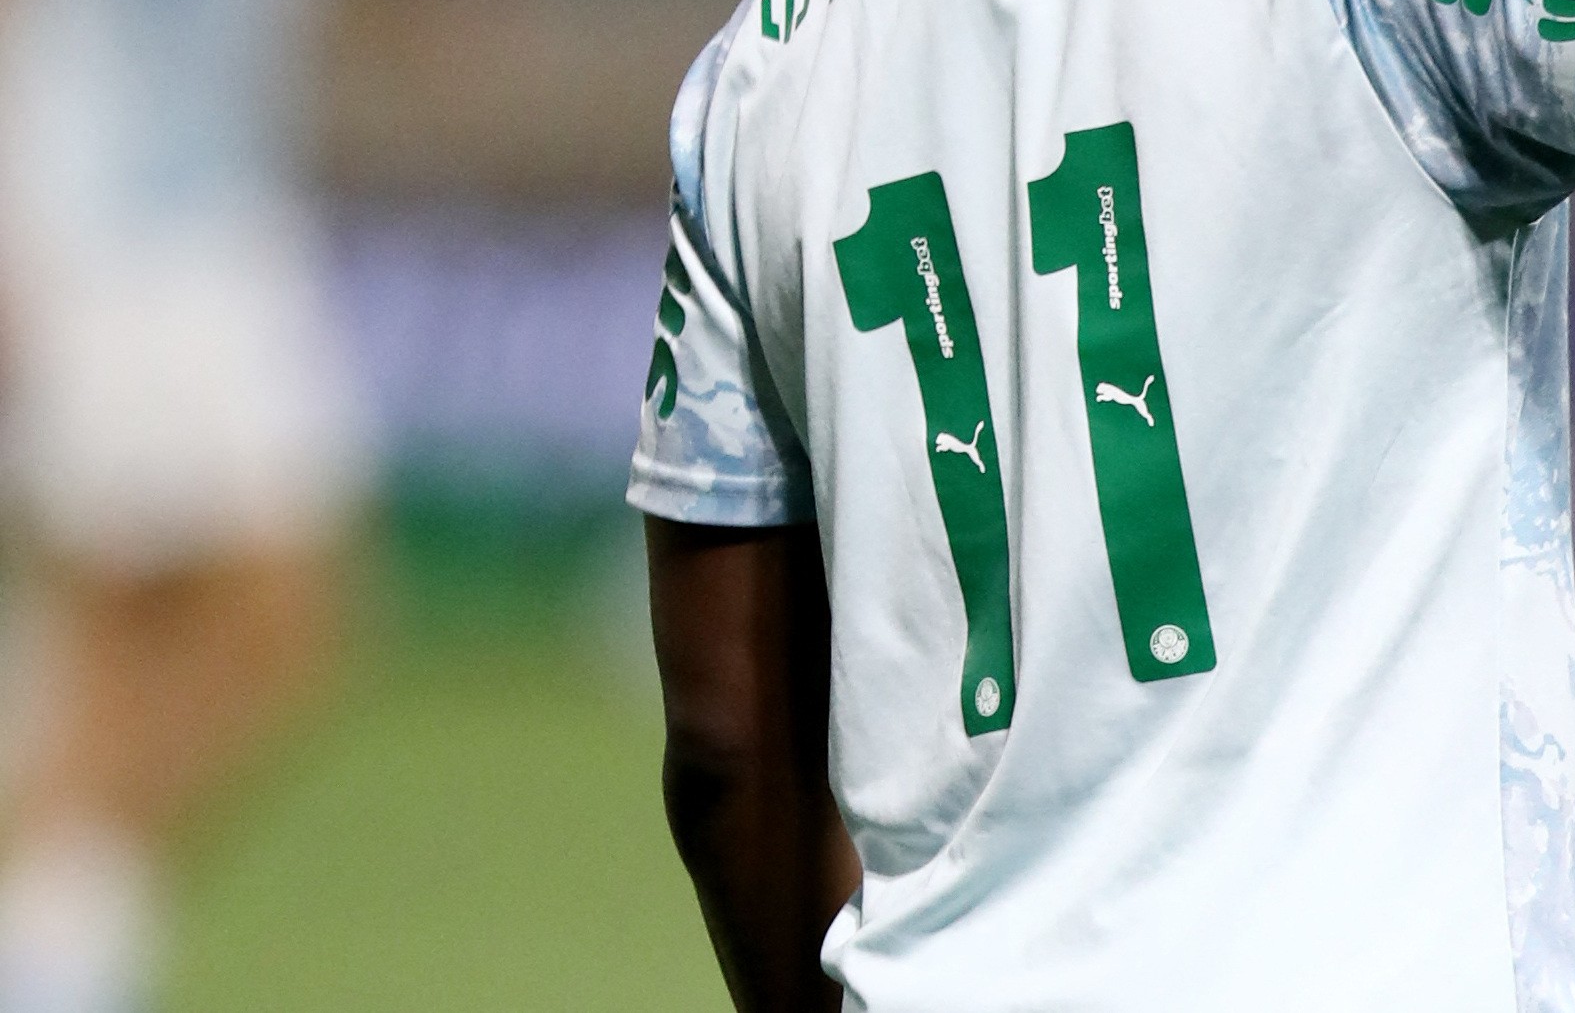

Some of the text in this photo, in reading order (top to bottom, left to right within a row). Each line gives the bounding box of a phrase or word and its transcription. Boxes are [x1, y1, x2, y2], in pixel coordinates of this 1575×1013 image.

[910, 236, 954, 359] sportingbet
[1097, 186, 1123, 310] sportingbet
[831, 120, 1218, 738] 11
